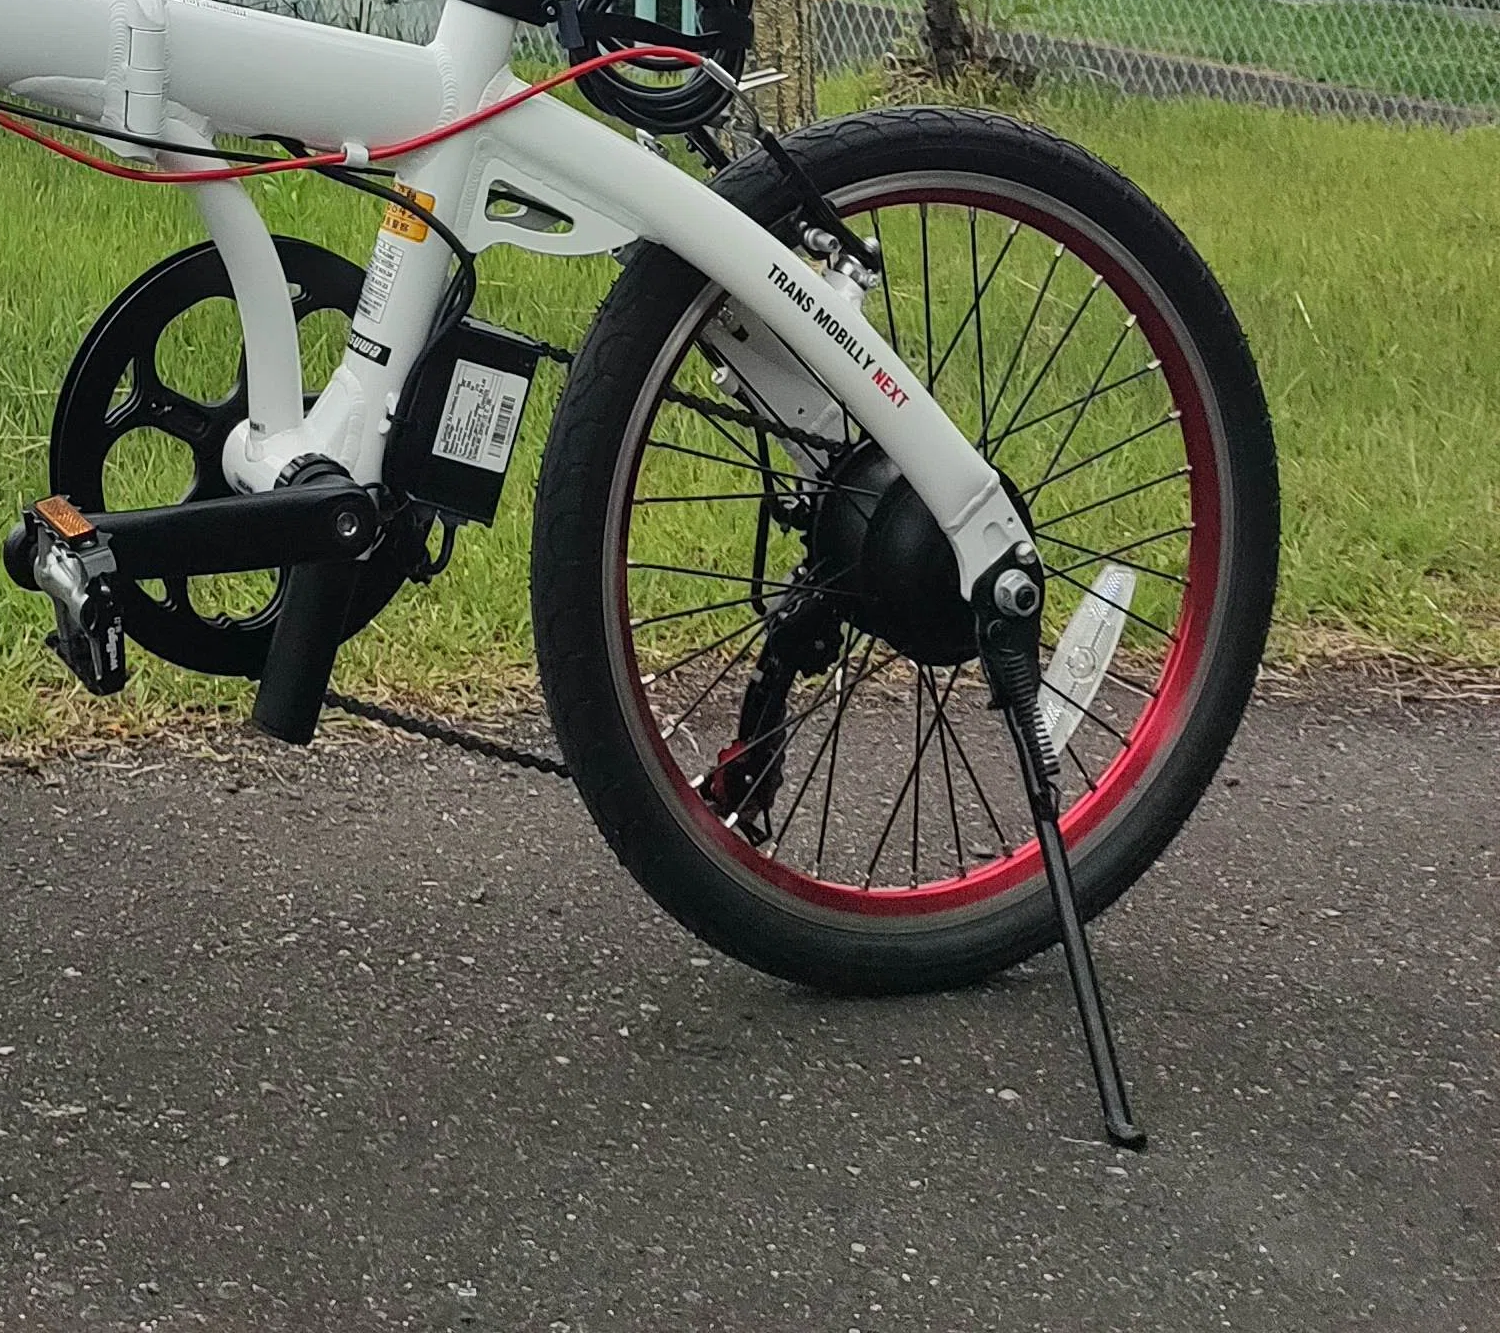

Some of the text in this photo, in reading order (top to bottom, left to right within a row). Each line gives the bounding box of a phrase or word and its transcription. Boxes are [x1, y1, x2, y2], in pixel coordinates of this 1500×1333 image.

[767, 263, 911, 409] TRANS MOBILLY NEXT
